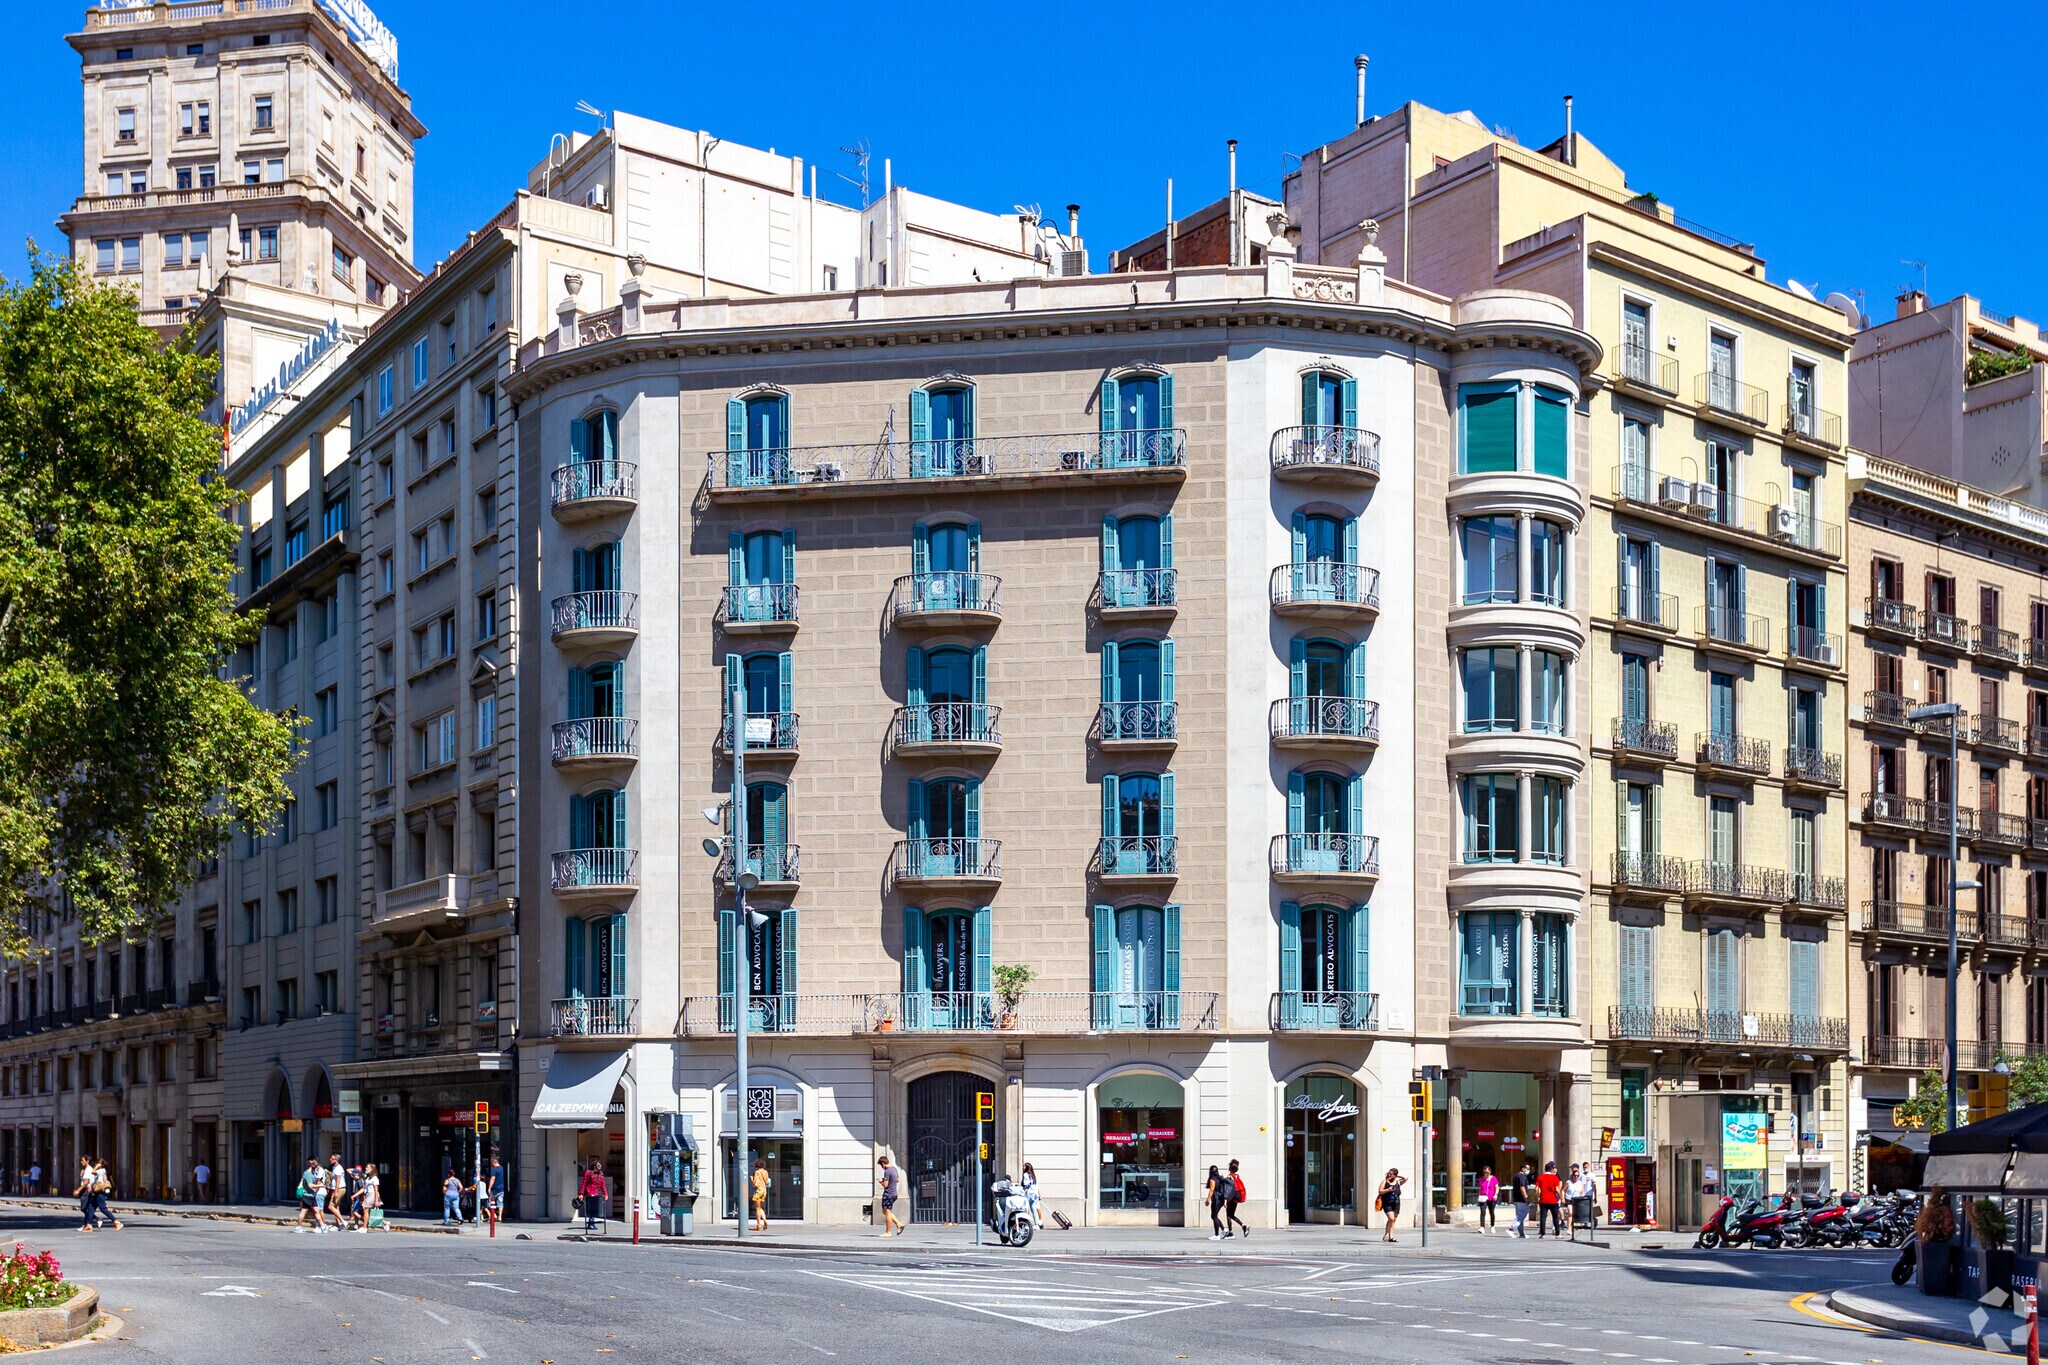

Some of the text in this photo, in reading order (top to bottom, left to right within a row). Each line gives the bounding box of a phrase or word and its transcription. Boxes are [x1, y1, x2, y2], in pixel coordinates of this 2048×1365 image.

[279, 317, 338, 390] Occidente
[1327, 914, 1335, 961] ADVOCATS
[936, 942, 944, 980] LAWYERS
[753, 973, 761, 991] BCN
[537, 1102, 605, 1113] CALZEDONIA
[2011, 1274, 2043, 1291] RASERIA
